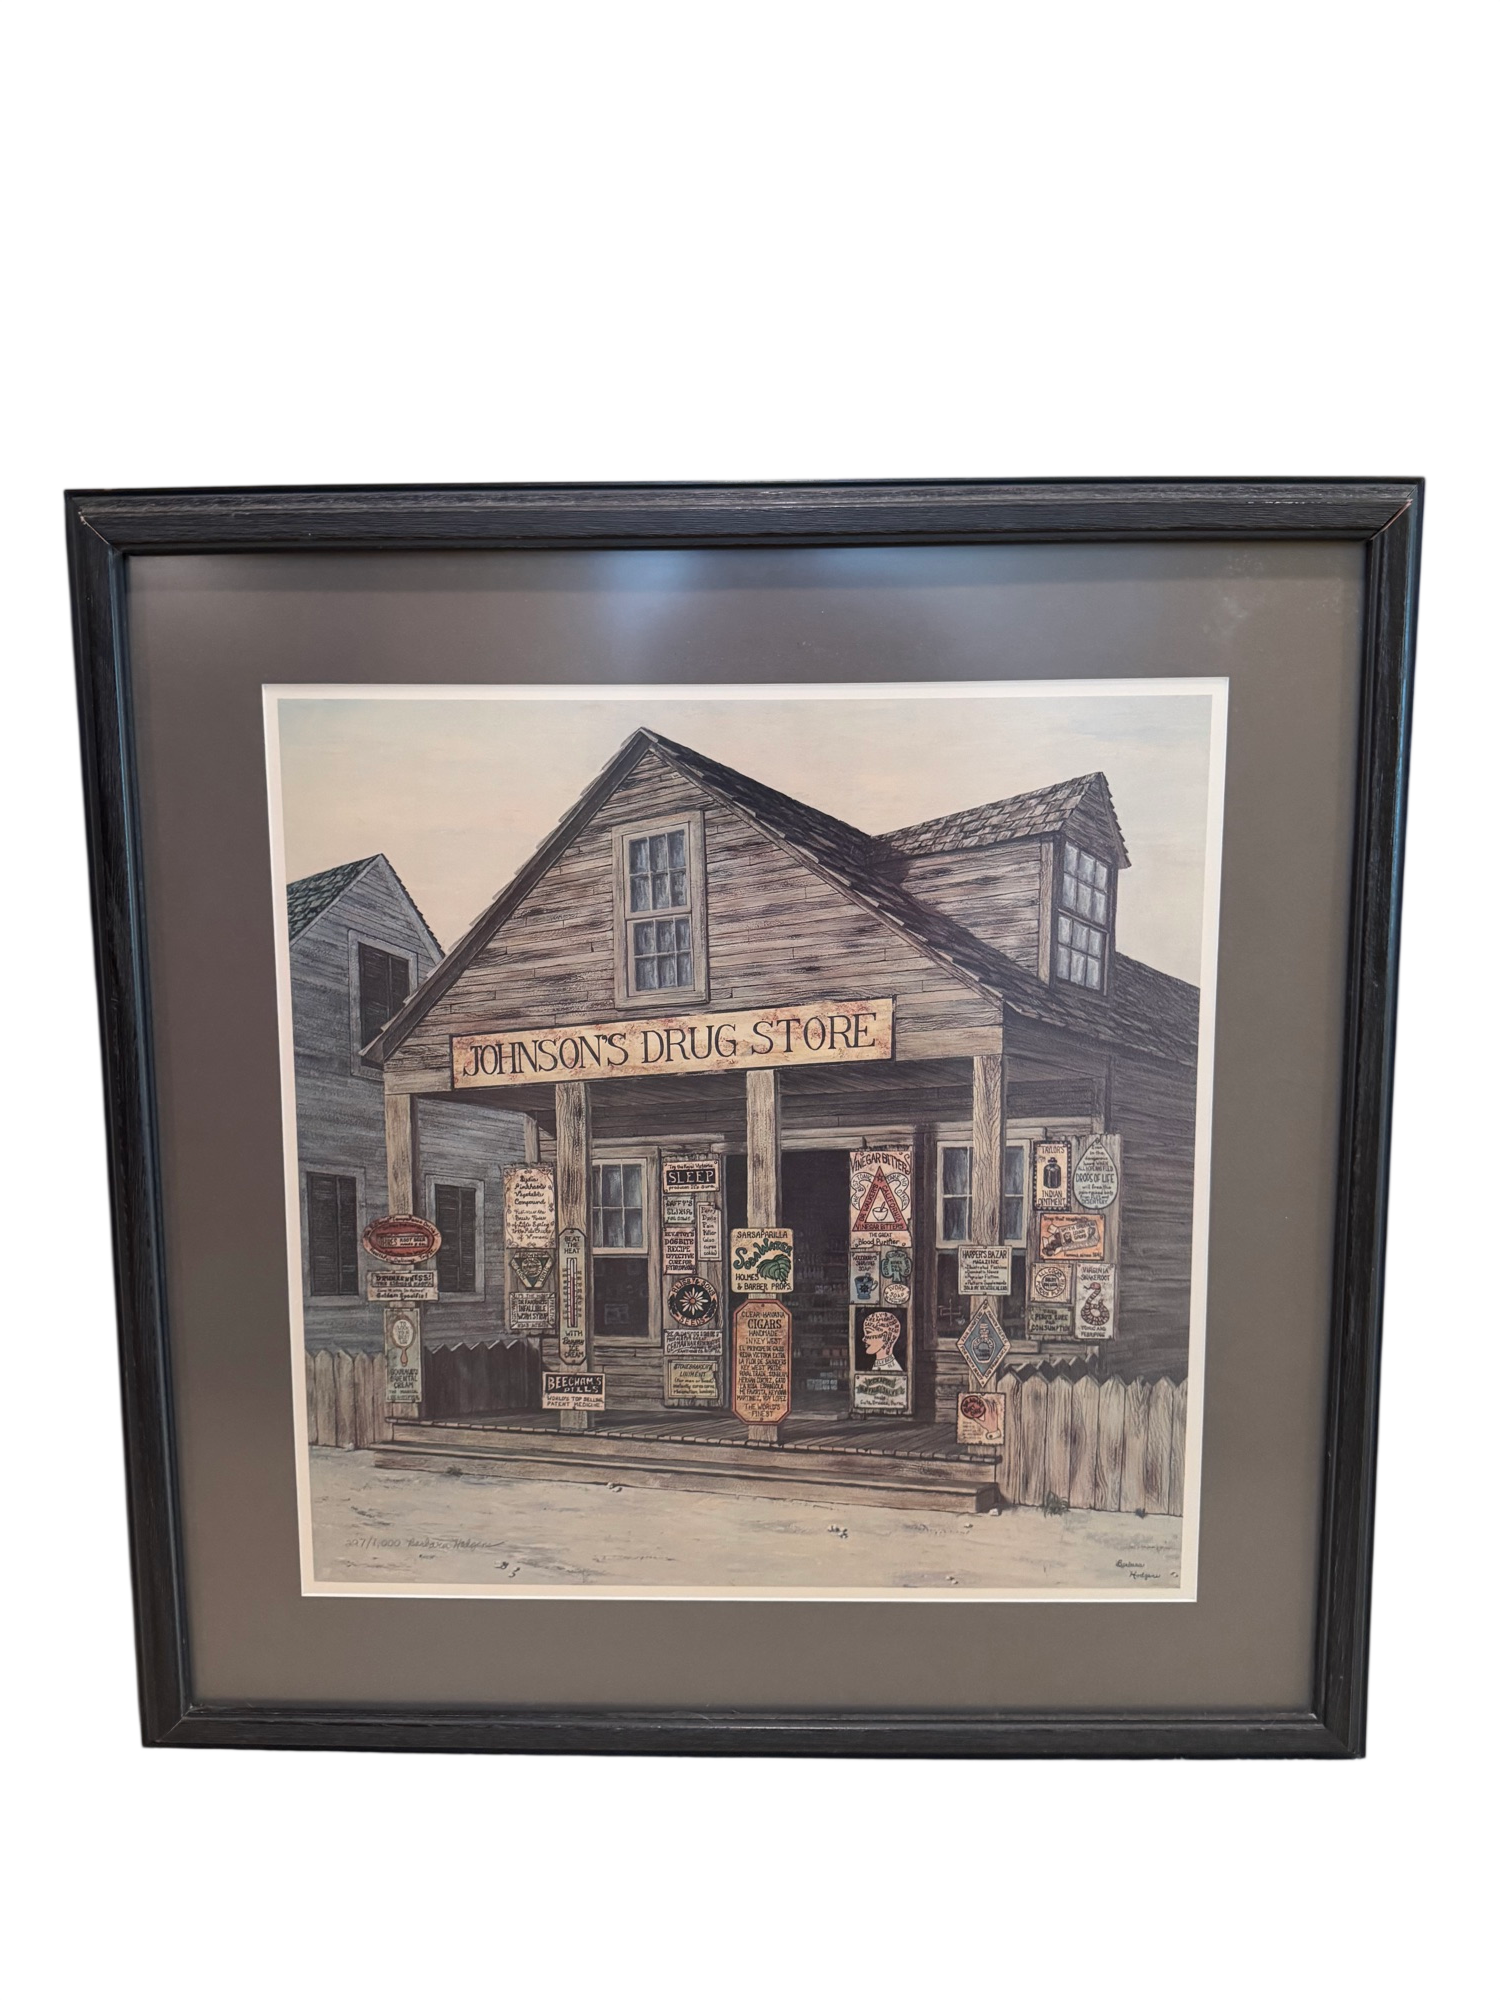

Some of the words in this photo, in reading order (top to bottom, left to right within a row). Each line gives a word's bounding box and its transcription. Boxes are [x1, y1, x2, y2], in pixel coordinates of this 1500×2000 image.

[463, 1032, 629, 1077] JOHNSON'S
[641, 1023, 738, 1064] DRUG
[751, 1012, 878, 1055] STORE
[850, 1152, 881, 1173] VINEGAR
[882, 1152, 912, 1175] BITTERS
[668, 1170, 714, 1184] SLEEP
[1075, 1173, 1093, 1183] DROPS
[1093, 1173, 1100, 1182] OF
[1101, 1173, 1115, 1183] LIFE
[882, 1185, 903, 1223] CALIFORNIA
[736, 1230, 788, 1239] SARSAPARILLA
[962, 1250, 987, 1259] HARPER'S
[987, 1250, 1008, 1259] BAZAR
[735, 1273, 760, 1281] HOLMES
[738, 1282, 743, 1290] &
[744, 1282, 769, 1290] BARBER
[747, 1319, 782, 1329] CIGARS
[547, 1376, 602, 1391] BEECHAM'S
